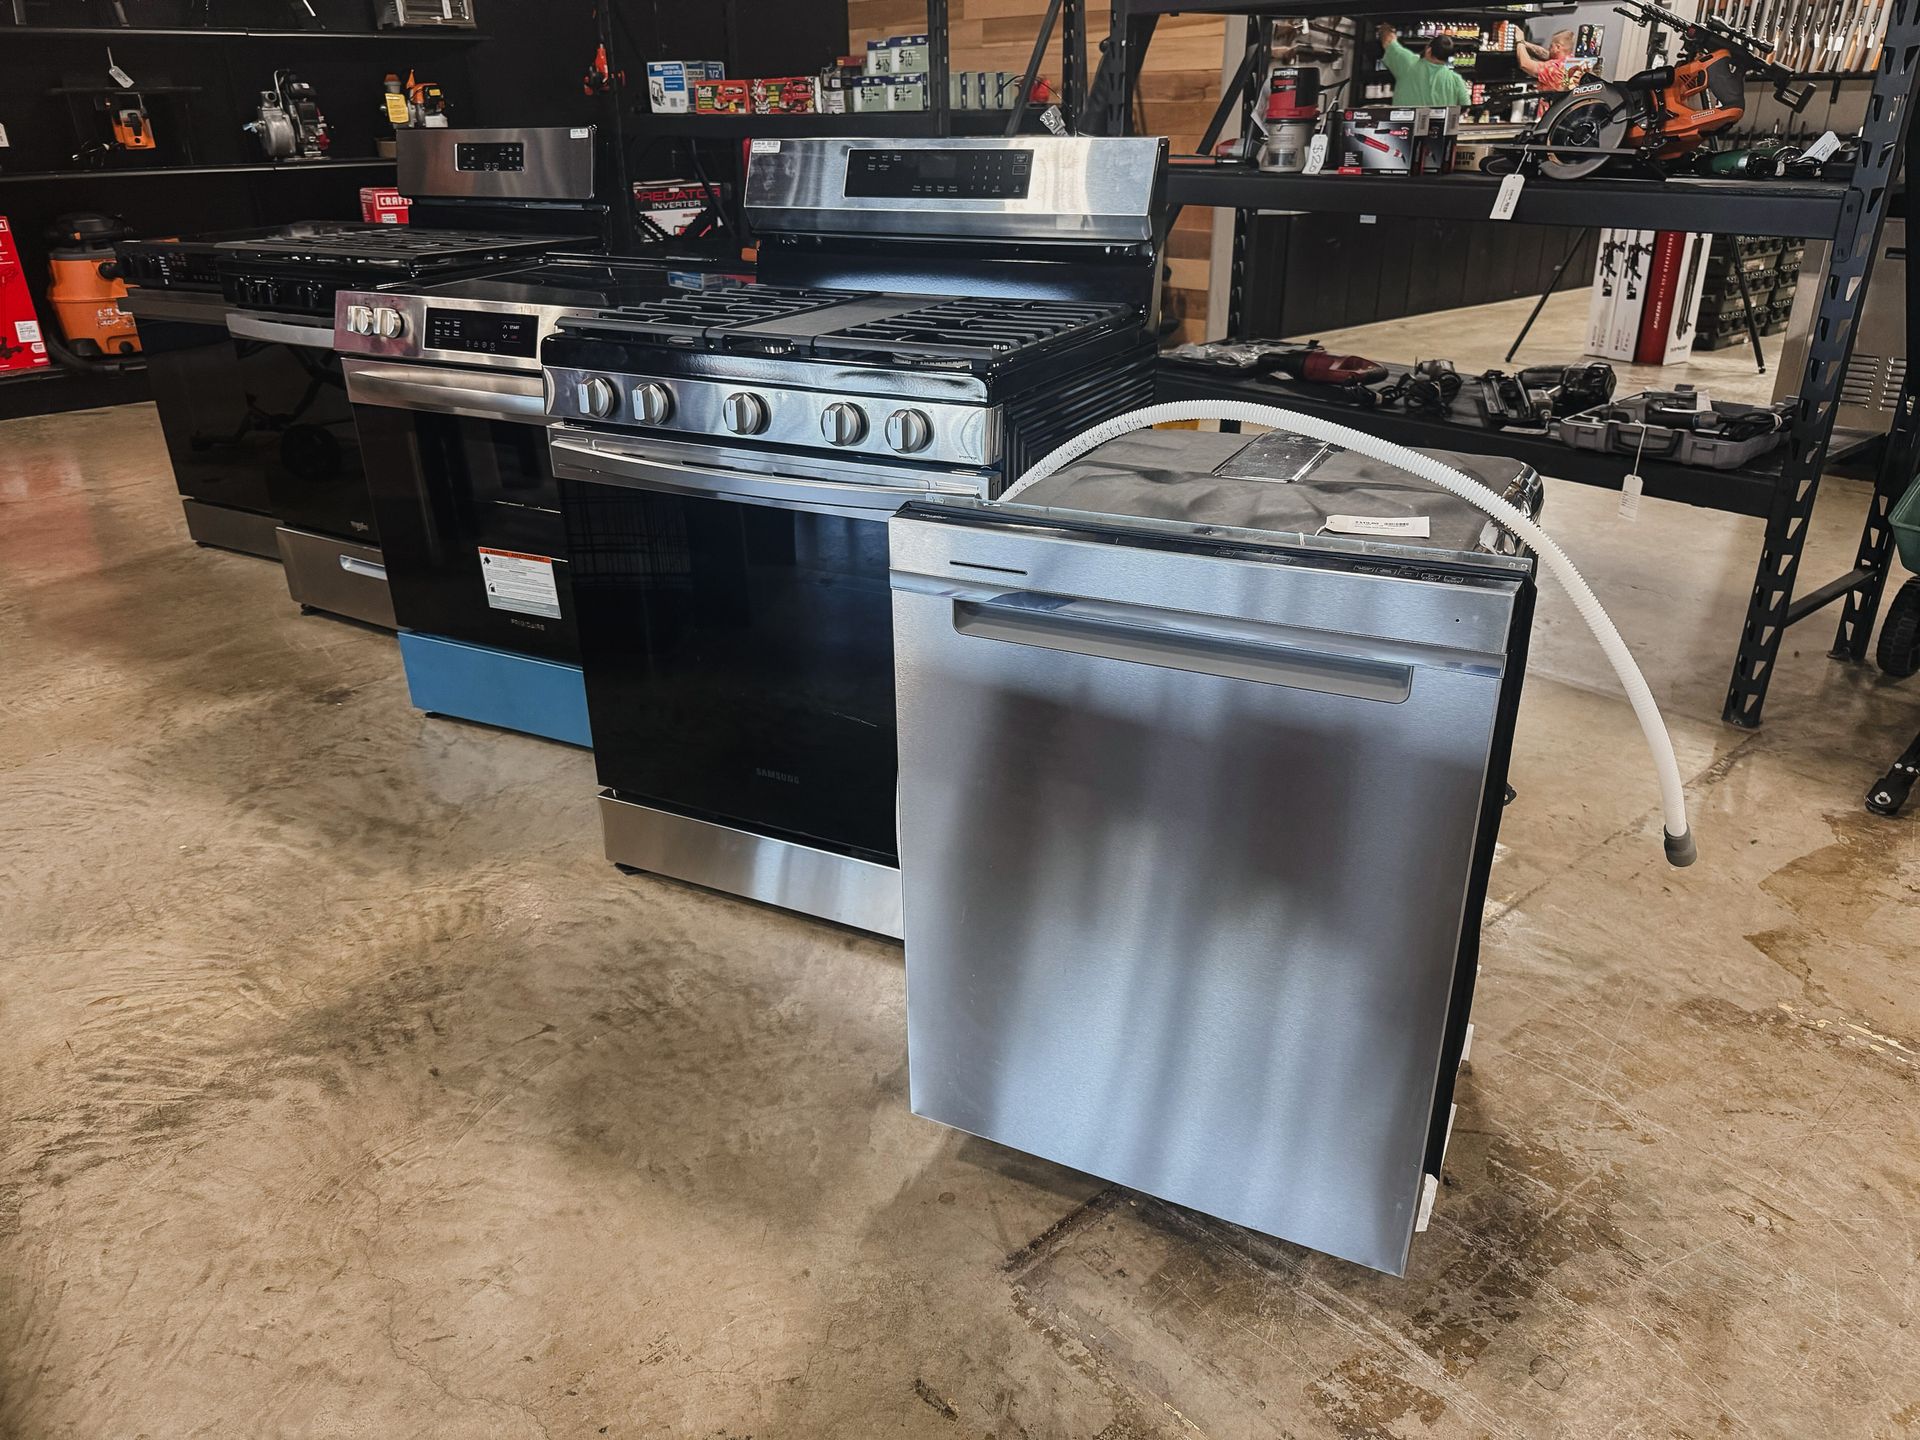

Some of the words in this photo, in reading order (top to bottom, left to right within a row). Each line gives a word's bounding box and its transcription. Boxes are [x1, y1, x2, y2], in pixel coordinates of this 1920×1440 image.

[1573, 83, 1603, 95] RIDGID
[652, 200, 702, 210] INVERTER
[756, 767, 800, 785] SAMSUNG
